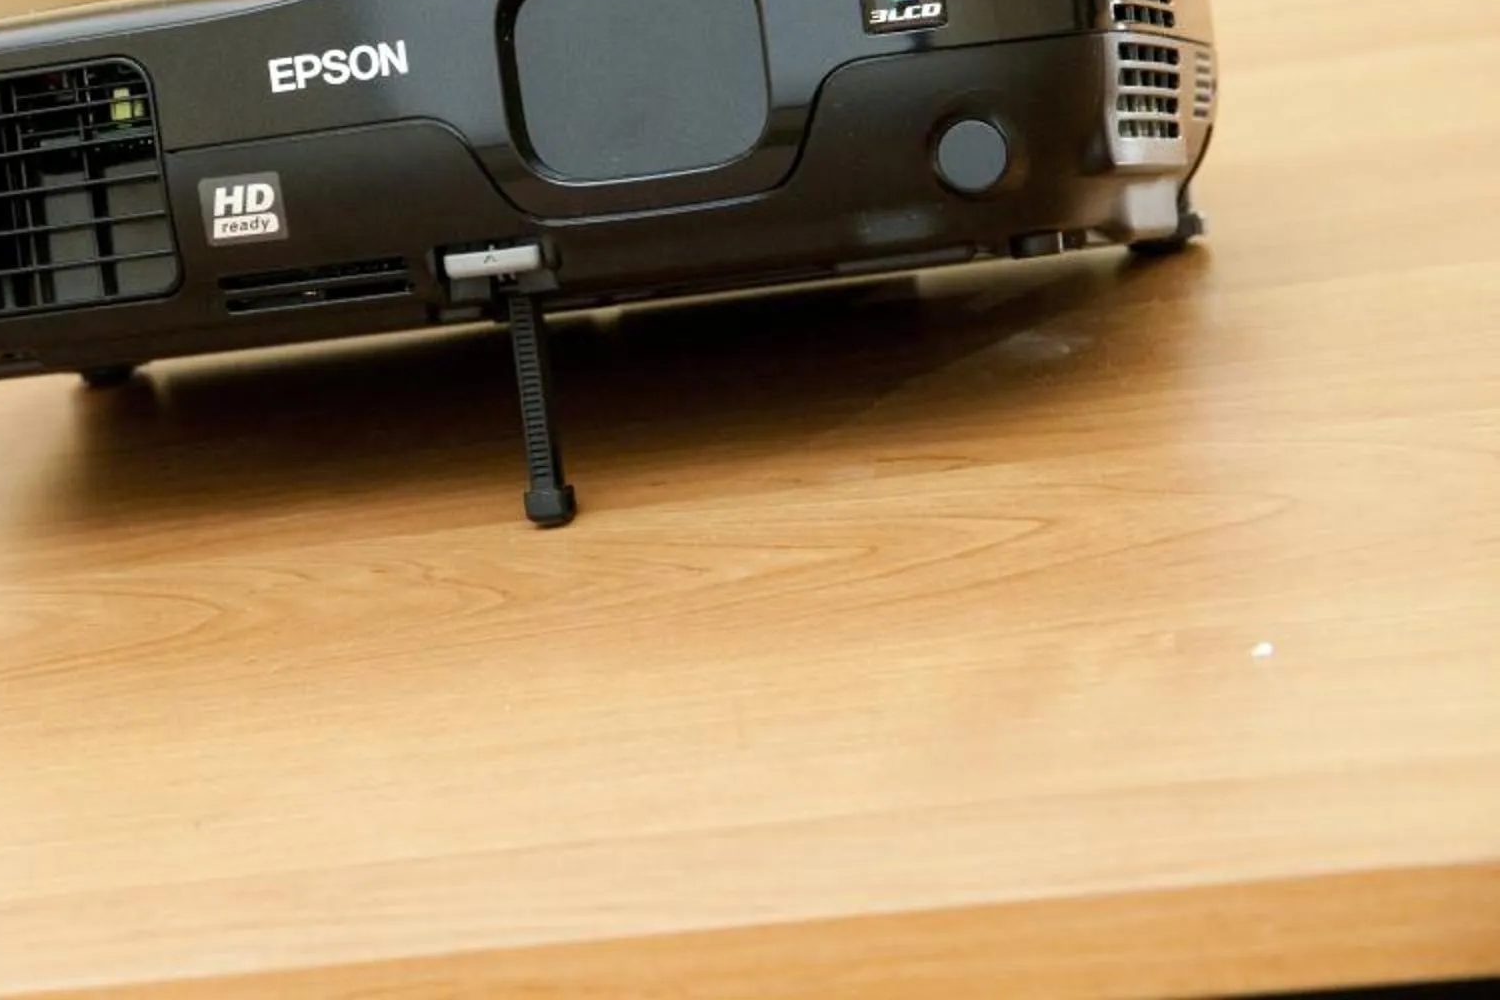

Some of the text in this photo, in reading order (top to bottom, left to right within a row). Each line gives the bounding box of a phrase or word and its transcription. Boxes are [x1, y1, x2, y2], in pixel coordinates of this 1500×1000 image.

[869, 2, 942, 24] 3LCD
[268, 40, 409, 93] EPSON
[213, 182, 275, 217] HD
[221, 215, 271, 233] ready
